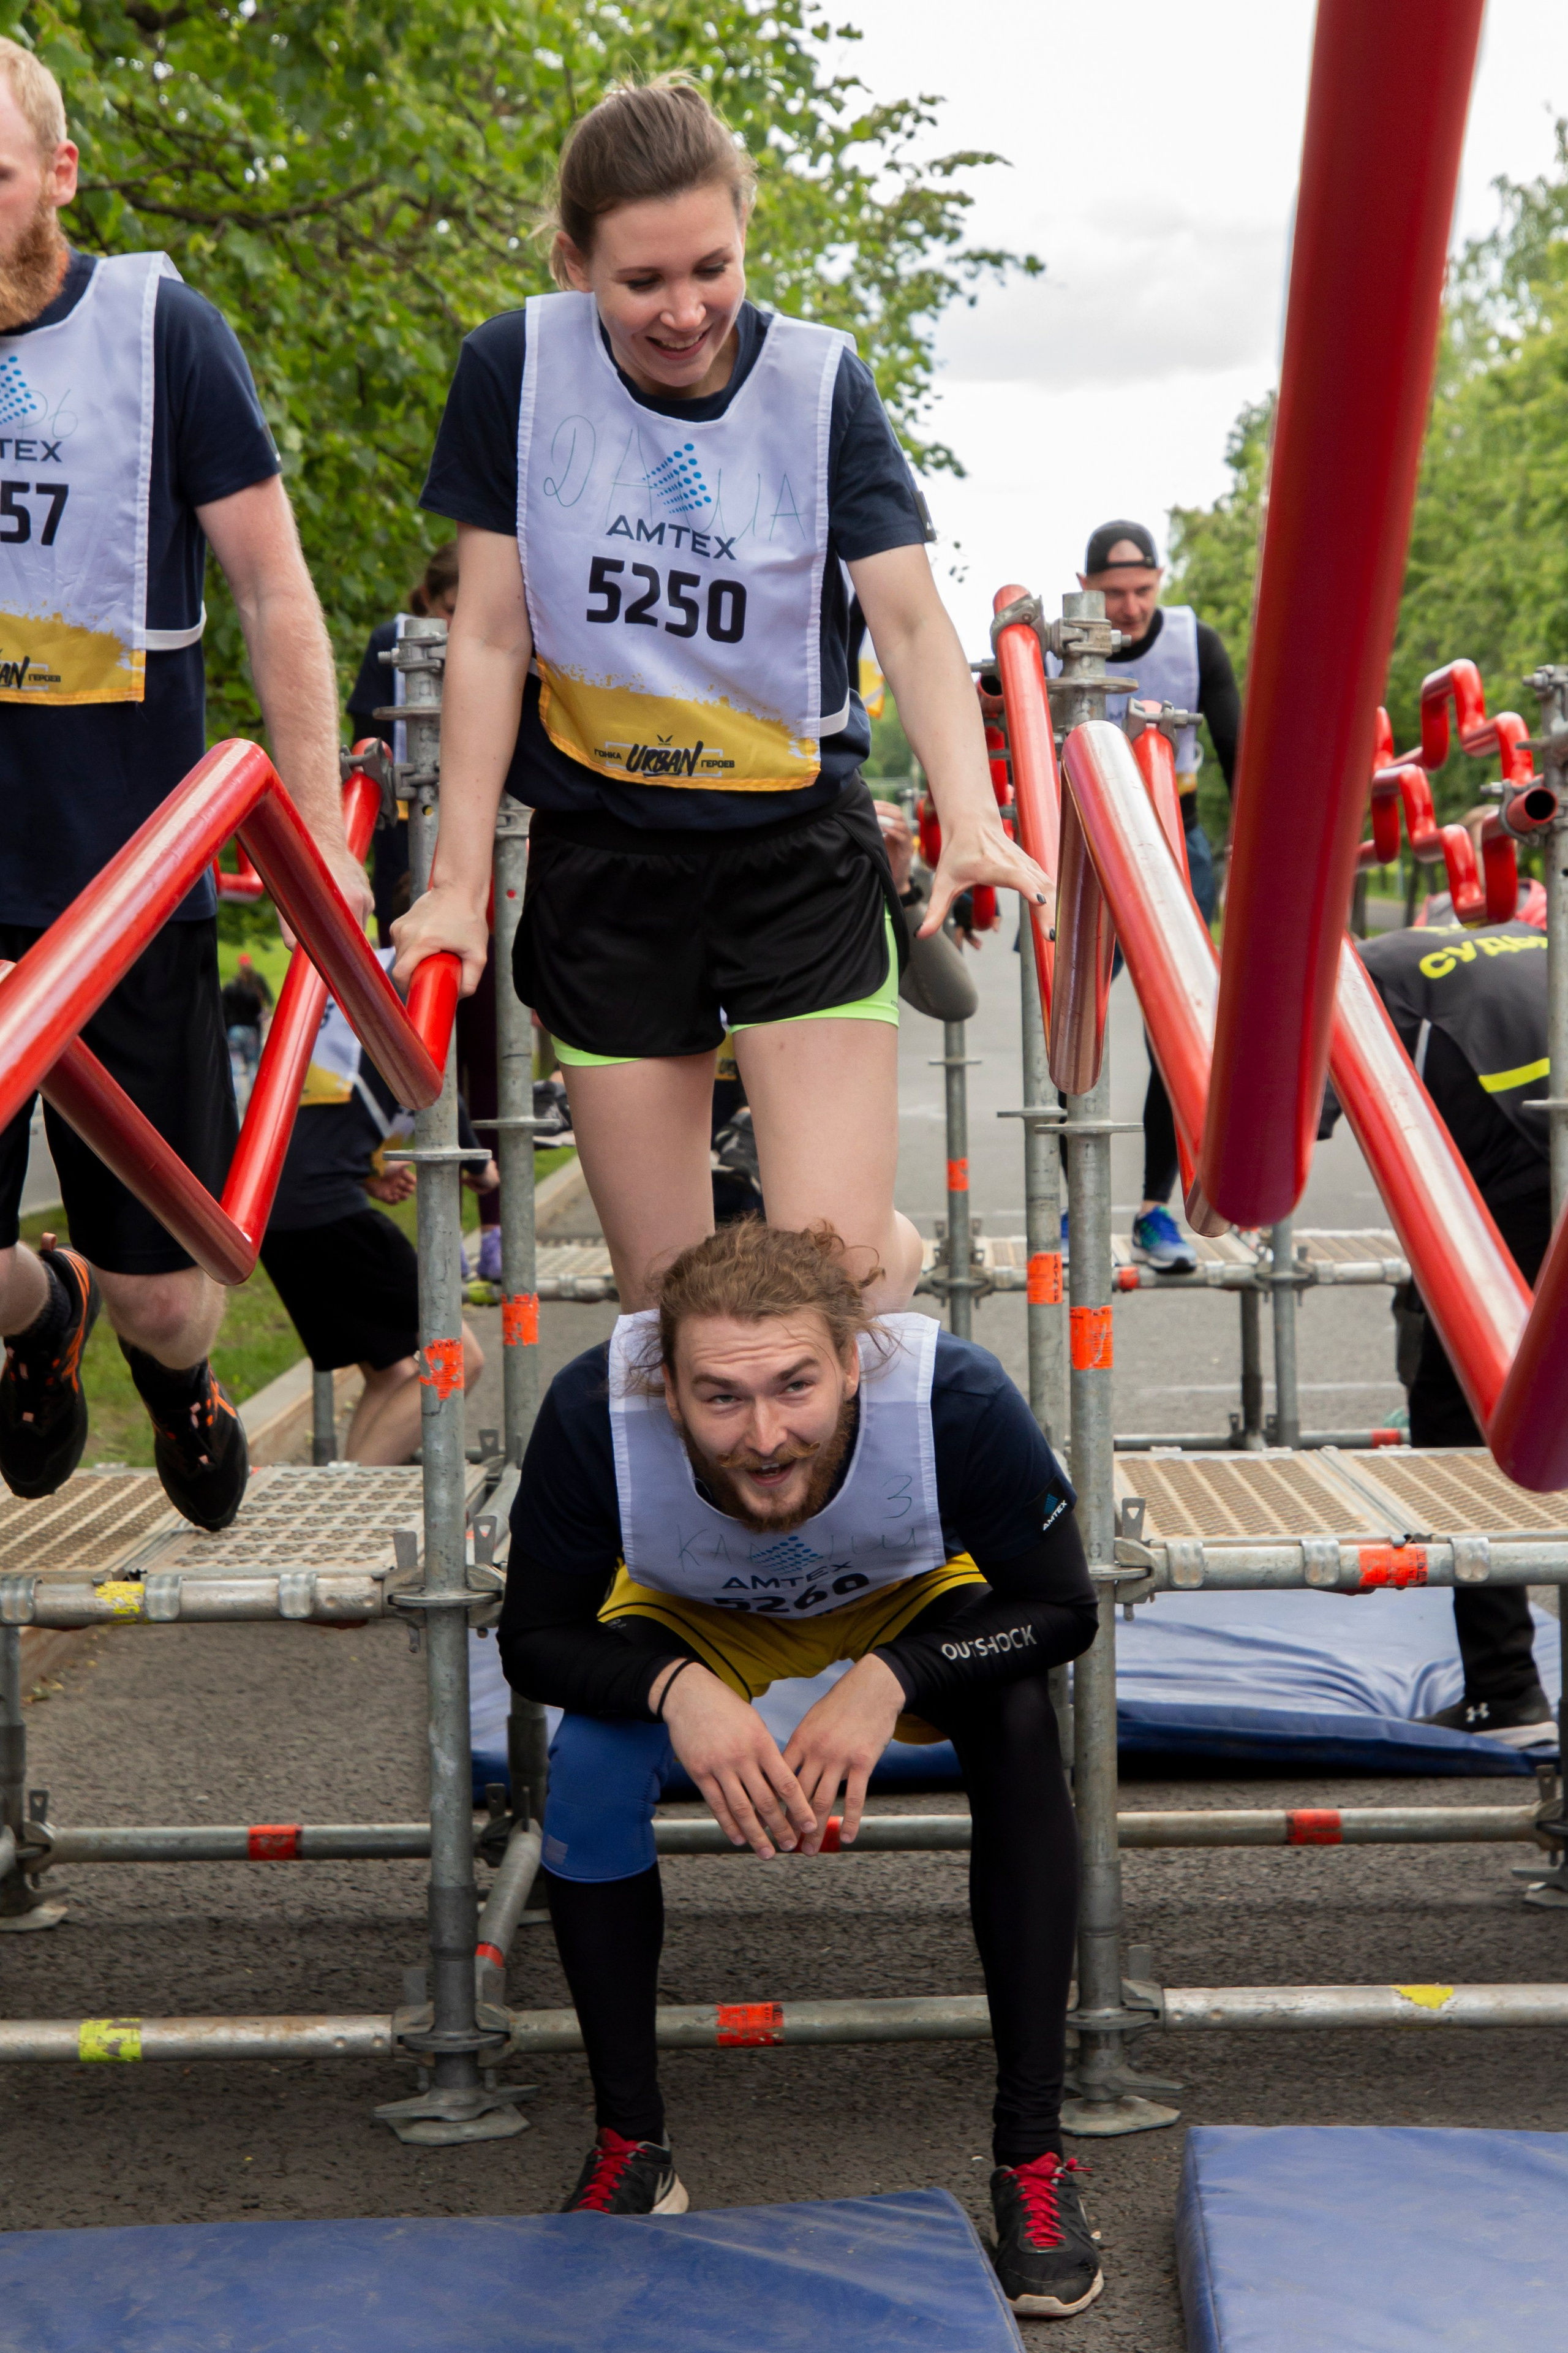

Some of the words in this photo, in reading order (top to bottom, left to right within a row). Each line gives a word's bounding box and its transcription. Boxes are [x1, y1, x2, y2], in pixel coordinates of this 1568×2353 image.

[0, 480, 69, 546] 57
[605, 514, 737, 561] AMTEX
[586, 556, 747, 644] 5250
[594, 748, 622, 760] ГОНКА
[625, 740, 704, 777] URBAN
[701, 759, 735, 768] ГЕРОЕВ
[1043, 1500, 1068, 1531] AMTEX
[712, 1573, 870, 1614] 5260
[722, 1560, 853, 1590] AMTEX
[941, 1624, 1038, 1661] OUTSHOCK
